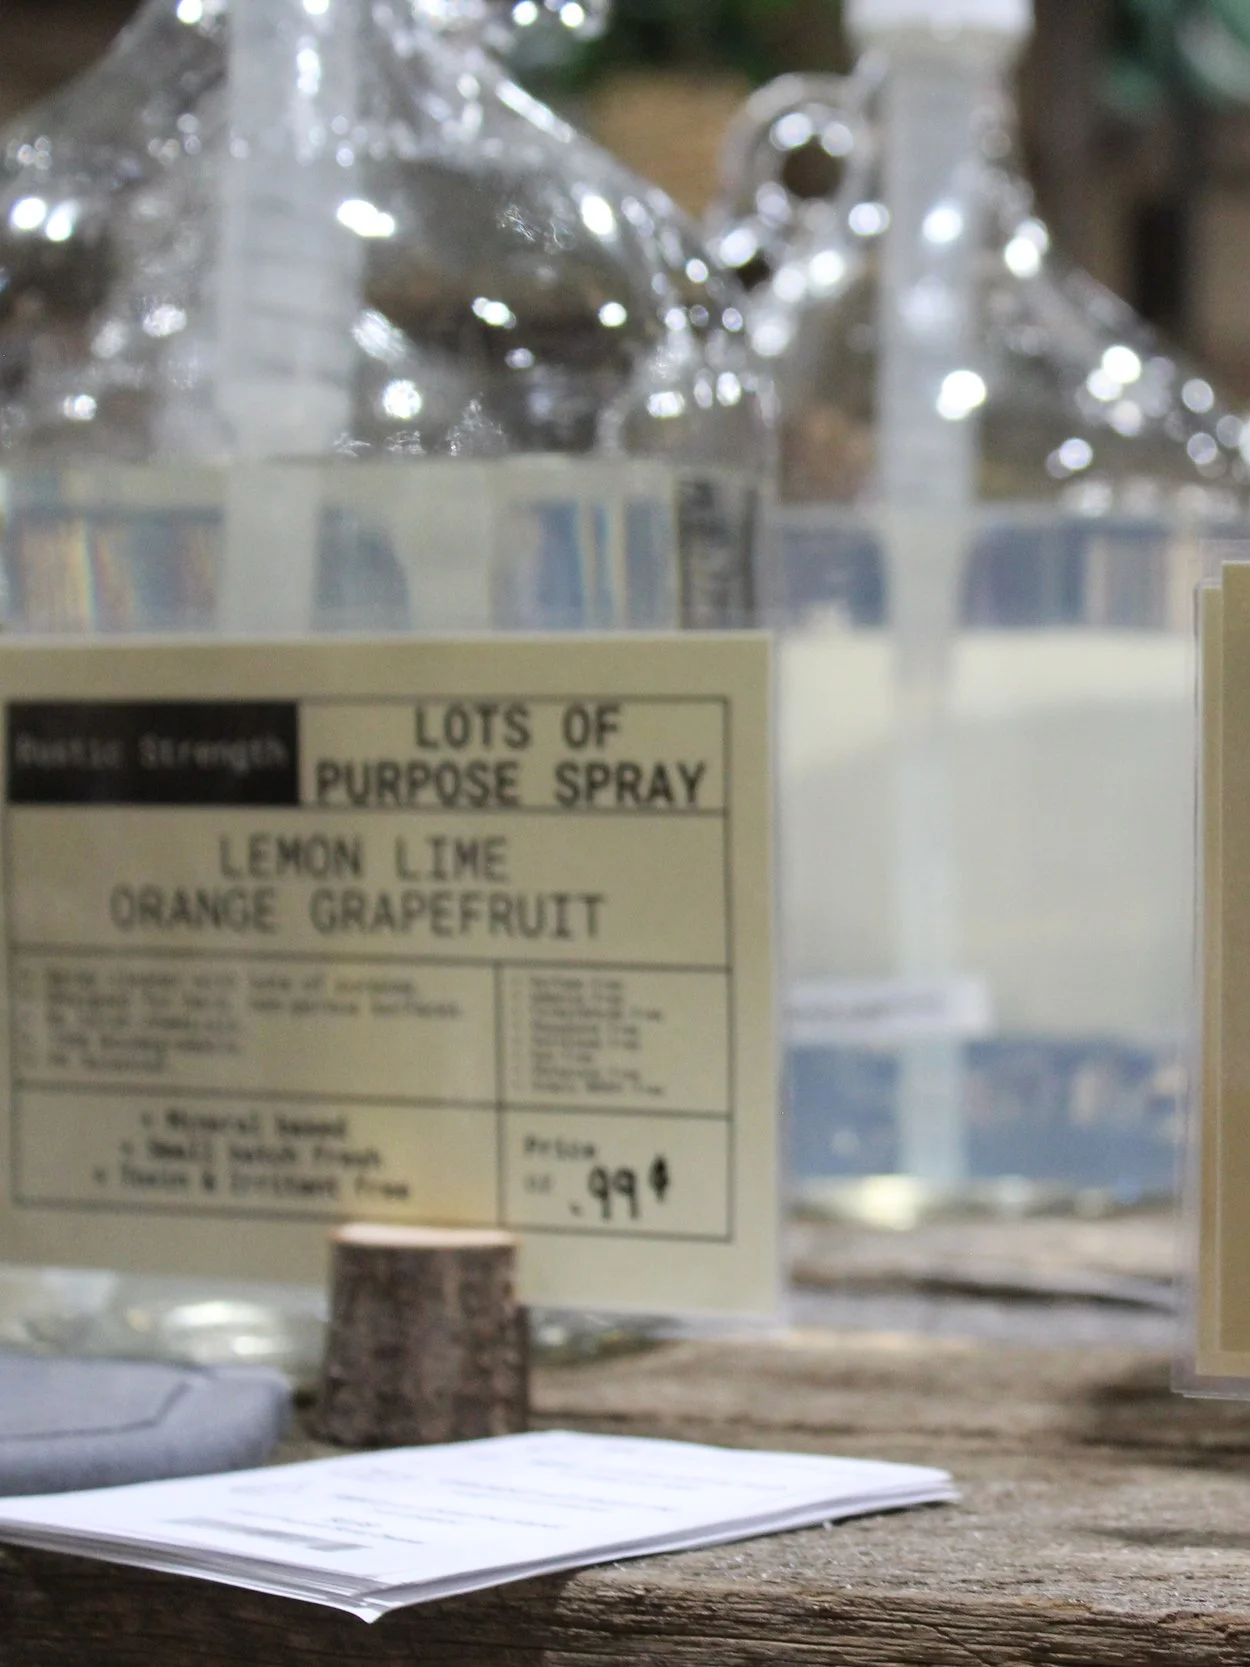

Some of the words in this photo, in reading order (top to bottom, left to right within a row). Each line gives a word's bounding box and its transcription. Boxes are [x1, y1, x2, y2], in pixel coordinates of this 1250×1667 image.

[415, 706, 531, 751] LOTS
[563, 706, 622, 748] OF
[139, 734, 289, 776] Strength
[317, 760, 520, 805] PURPOSE
[556, 763, 706, 806] SPRAY
[218, 833, 363, 881] LEMON
[395, 835, 511, 882] LIME
[109, 885, 278, 935] ORANGE
[309, 890, 605, 940] GRAPEFRUIT
